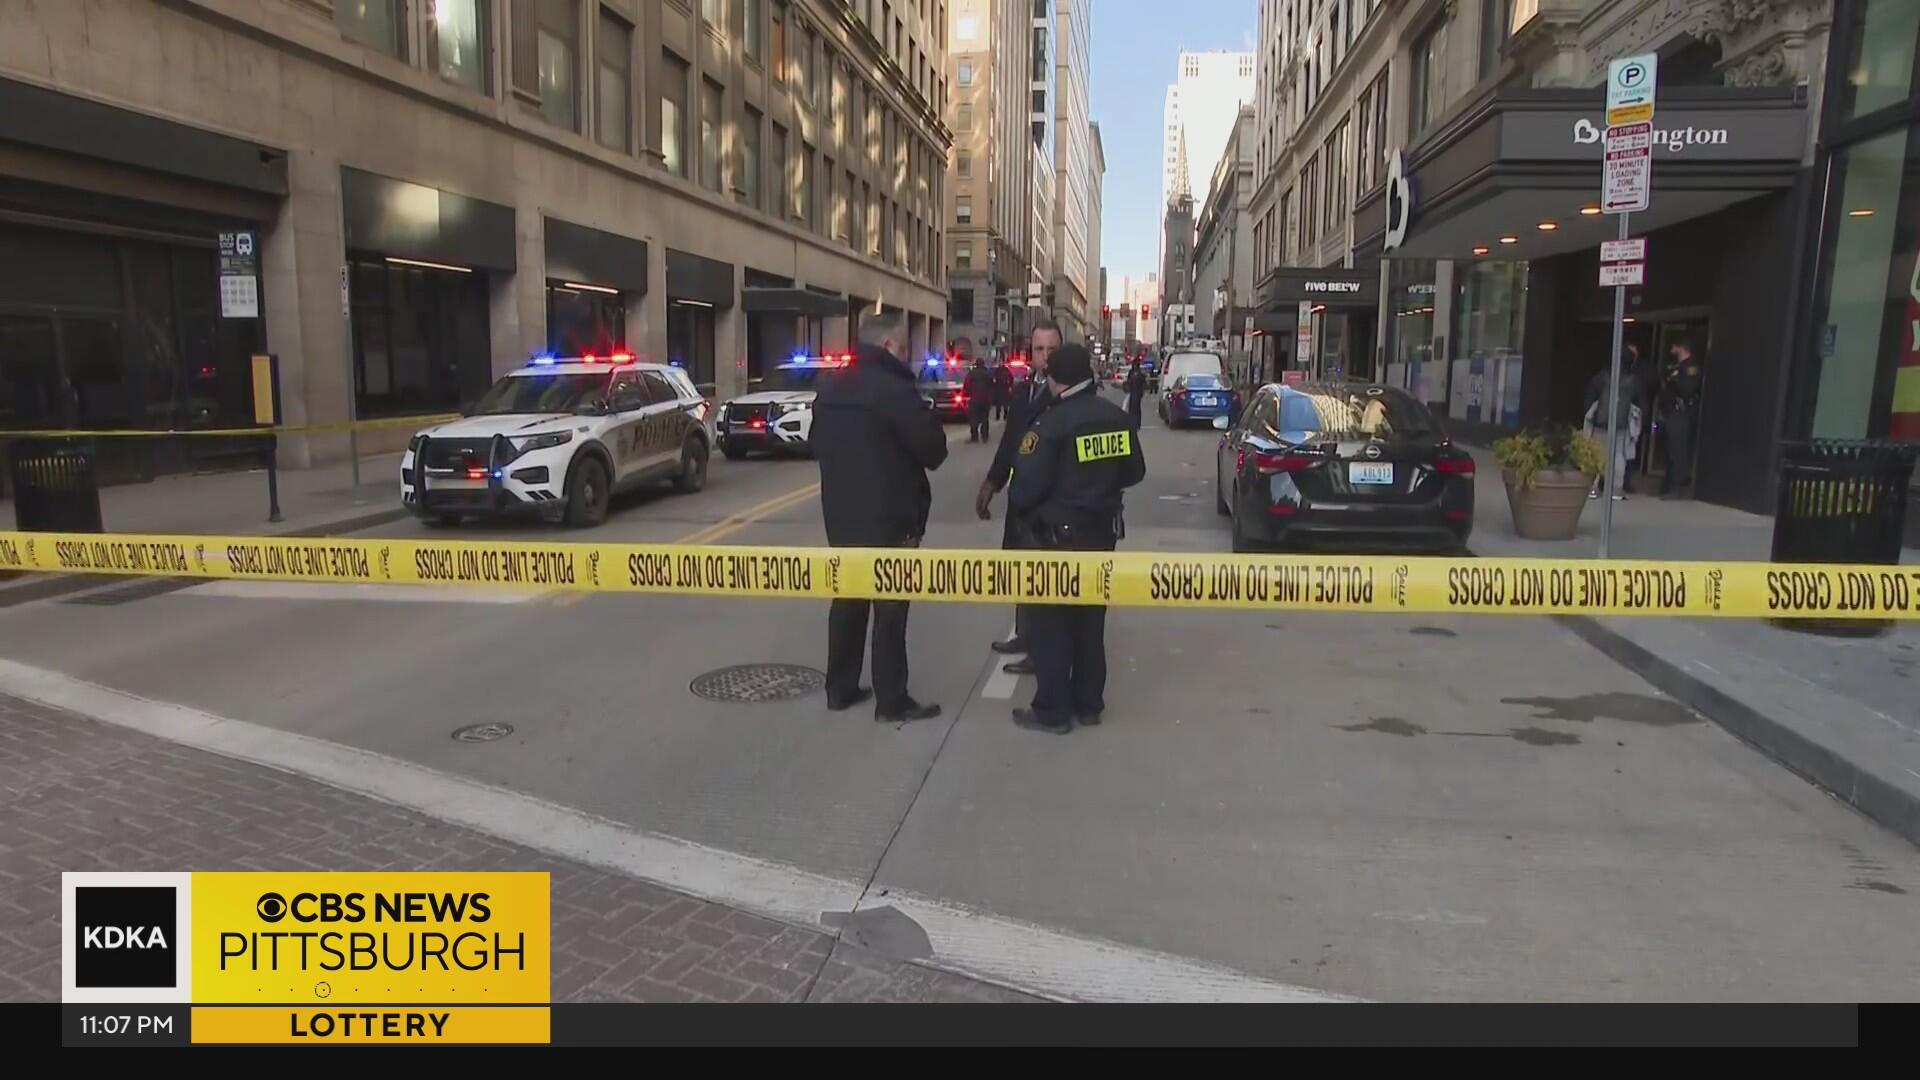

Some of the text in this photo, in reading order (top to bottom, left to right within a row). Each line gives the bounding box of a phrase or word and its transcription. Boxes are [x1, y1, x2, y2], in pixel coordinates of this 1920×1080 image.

[1609, 125, 1649, 137] NO STOPPING
[1620, 149, 1644, 158] PARKING
[1620, 160, 1645, 169] MINUTE
[1611, 169, 1642, 179] LOADING
[1616, 178, 1635, 187] ZONE
[219, 232, 234, 242] BUS
[1084, 434, 1124, 458] POLICE
[56, 541, 91, 568] CROSS
[90, 542, 112, 568] NOT
[111, 543, 128, 569] DO
[126, 543, 152, 569] LINE
[150, 543, 188, 571] POLICE
[227, 545, 263, 573] CROSS
[265, 545, 286, 574] NOT
[287, 546, 304, 574] DO
[304, 547, 330, 575] LINE
[330, 547, 370, 577] POLICE
[415, 548, 453, 579] CROSS
[457, 550, 480, 581] NOT
[482, 550, 499, 581] DO
[501, 550, 529, 583] LINE
[531, 551, 575, 584] POLICE
[628, 553, 811, 590] POLICE LINE DO NOT CROSS
[874, 558, 1080, 598] POLICE LINE DO NOT CROSS
[1151, 562, 1373, 603] POLICE LINE DO NOT CROSS
[1449, 567, 1686, 608] POLICE LINE DO NOT CROSS
[1767, 571, 1831, 610] CROSS
[1837, 571, 1875, 611] NOT
[1880, 572, 1909, 611] DO
